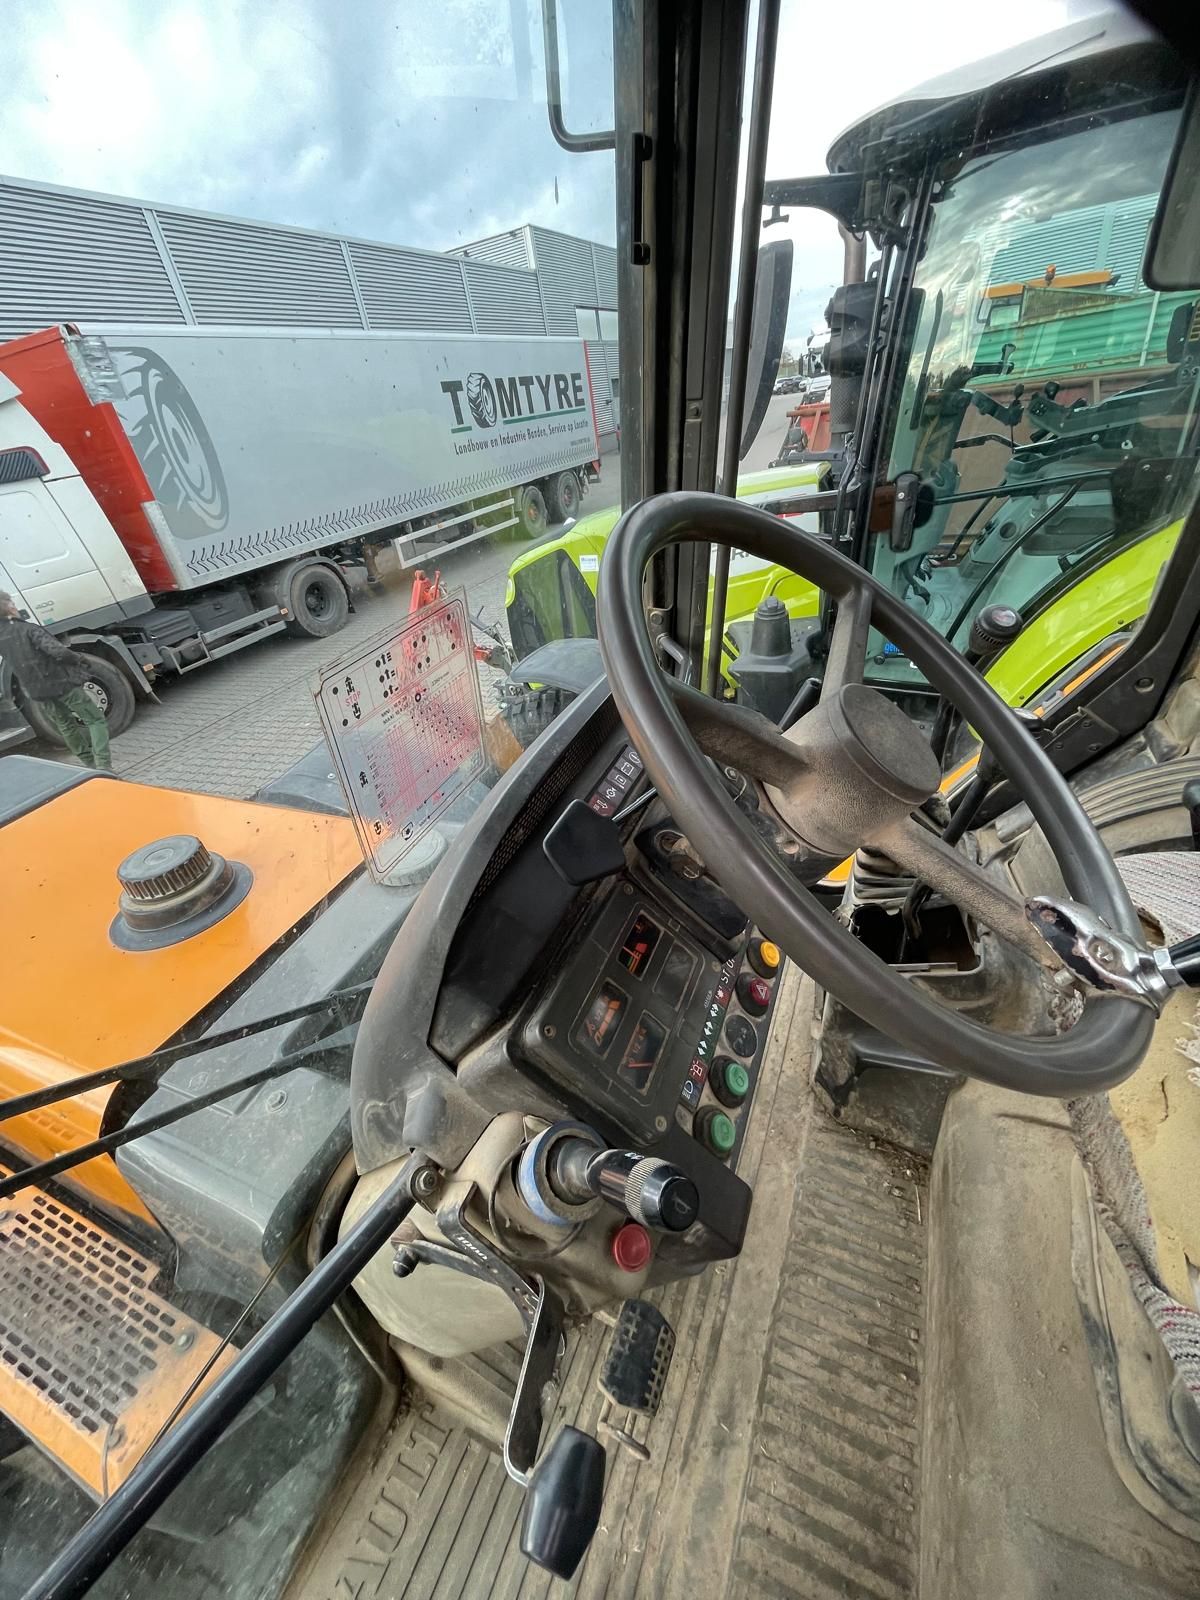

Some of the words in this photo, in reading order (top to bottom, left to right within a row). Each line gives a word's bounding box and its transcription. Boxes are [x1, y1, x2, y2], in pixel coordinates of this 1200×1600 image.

[454, 438, 489, 456] Landbouw
[490, 438, 499, 448] en
[499, 433, 527, 446] Industrie
[548, 423, 567, 435] Service
[567, 424, 574, 433] op
[345, 690, 361, 707] STOP
